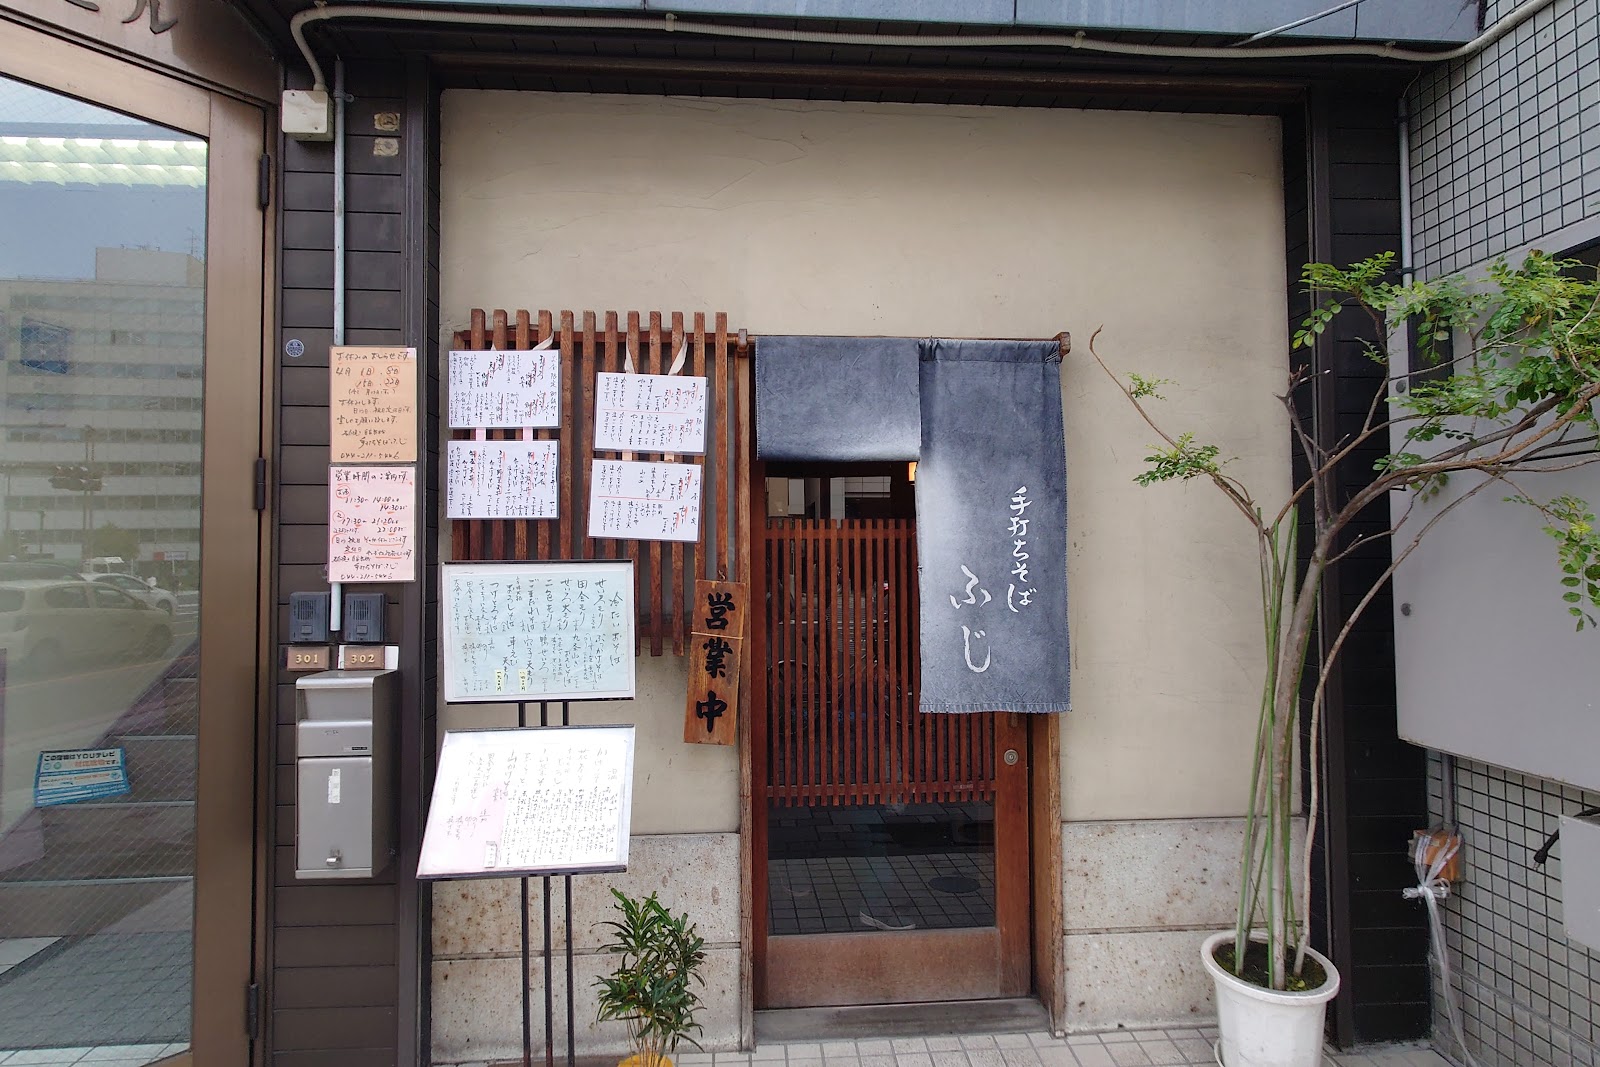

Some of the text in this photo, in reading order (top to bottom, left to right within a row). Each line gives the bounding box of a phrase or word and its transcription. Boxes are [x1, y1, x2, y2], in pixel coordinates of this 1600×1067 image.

[1007, 485, 1037, 613] 手打ちそば
[295, 654, 319, 664] 301
[351, 654, 376, 664] 302
[695, 591, 735, 733] 営業中
[949, 564, 992, 673] ふじ
